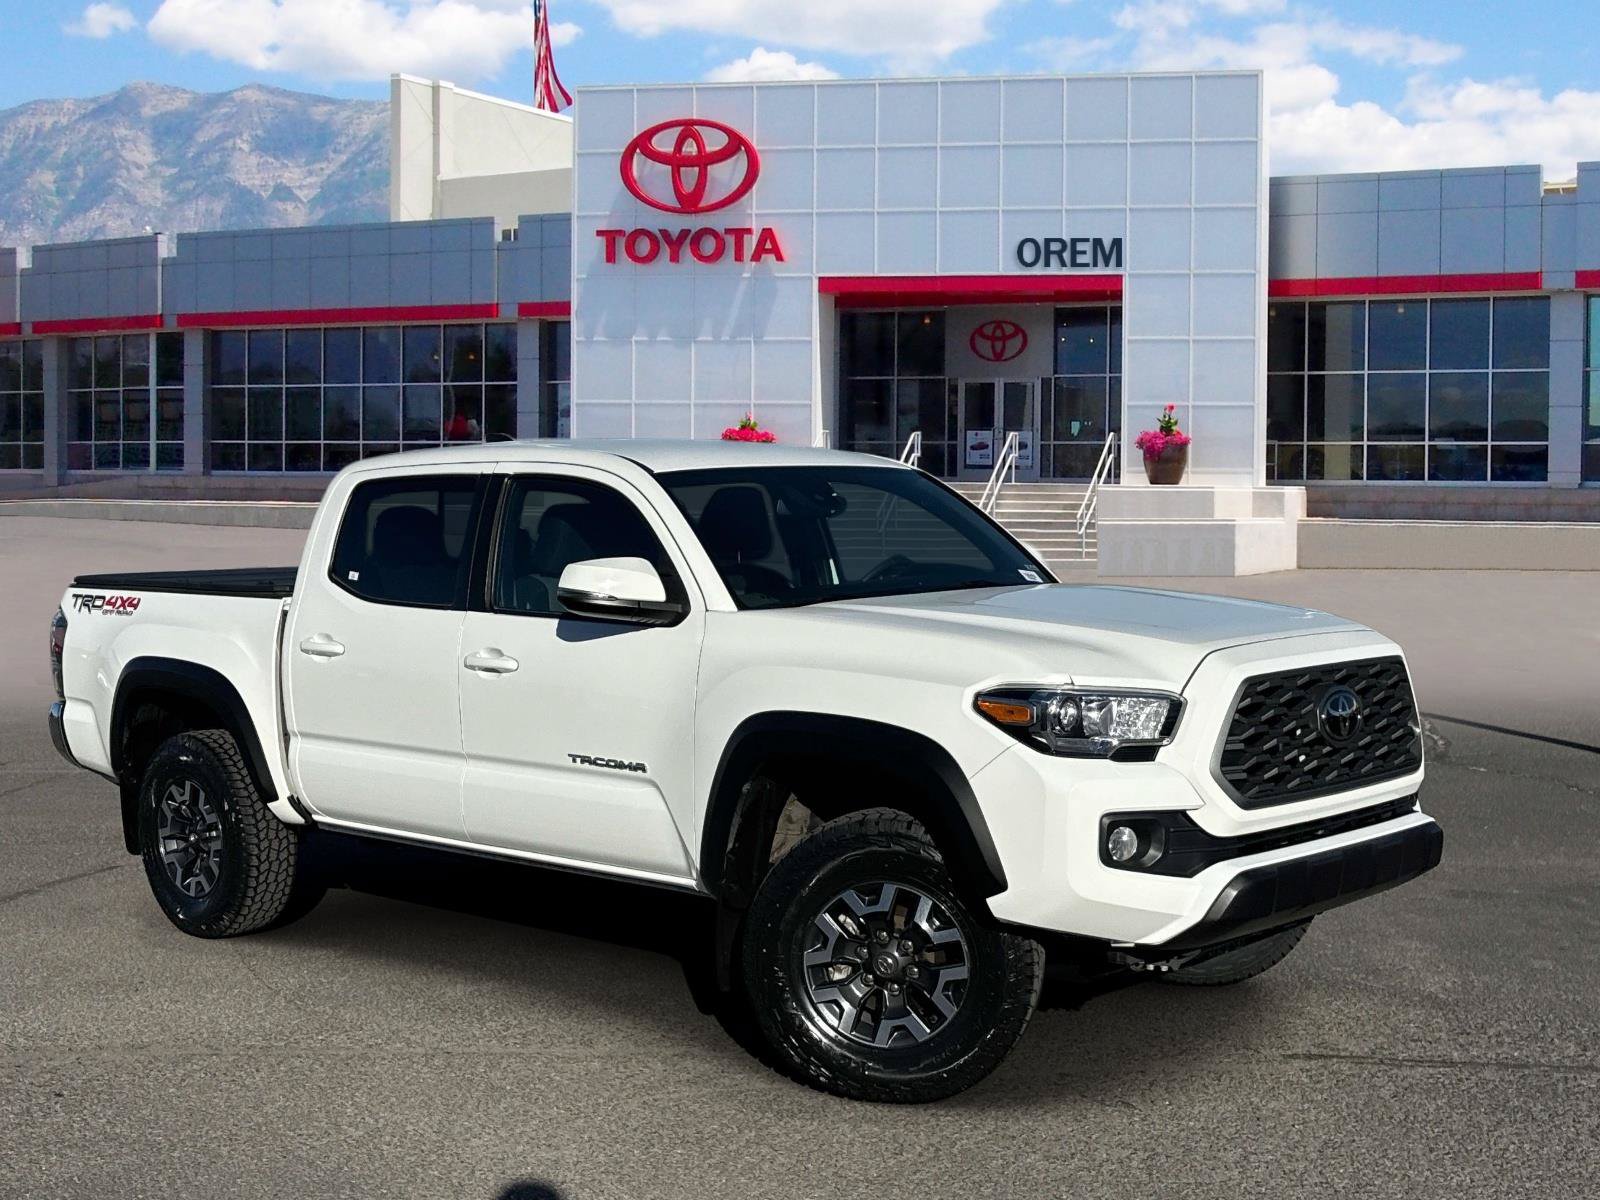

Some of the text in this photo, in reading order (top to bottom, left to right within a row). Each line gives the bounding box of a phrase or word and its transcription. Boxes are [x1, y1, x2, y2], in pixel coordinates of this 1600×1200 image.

[595, 227, 785, 264] TOYOTA
[1017, 237, 1123, 268] OREM
[567, 753, 647, 773] TACOMA
